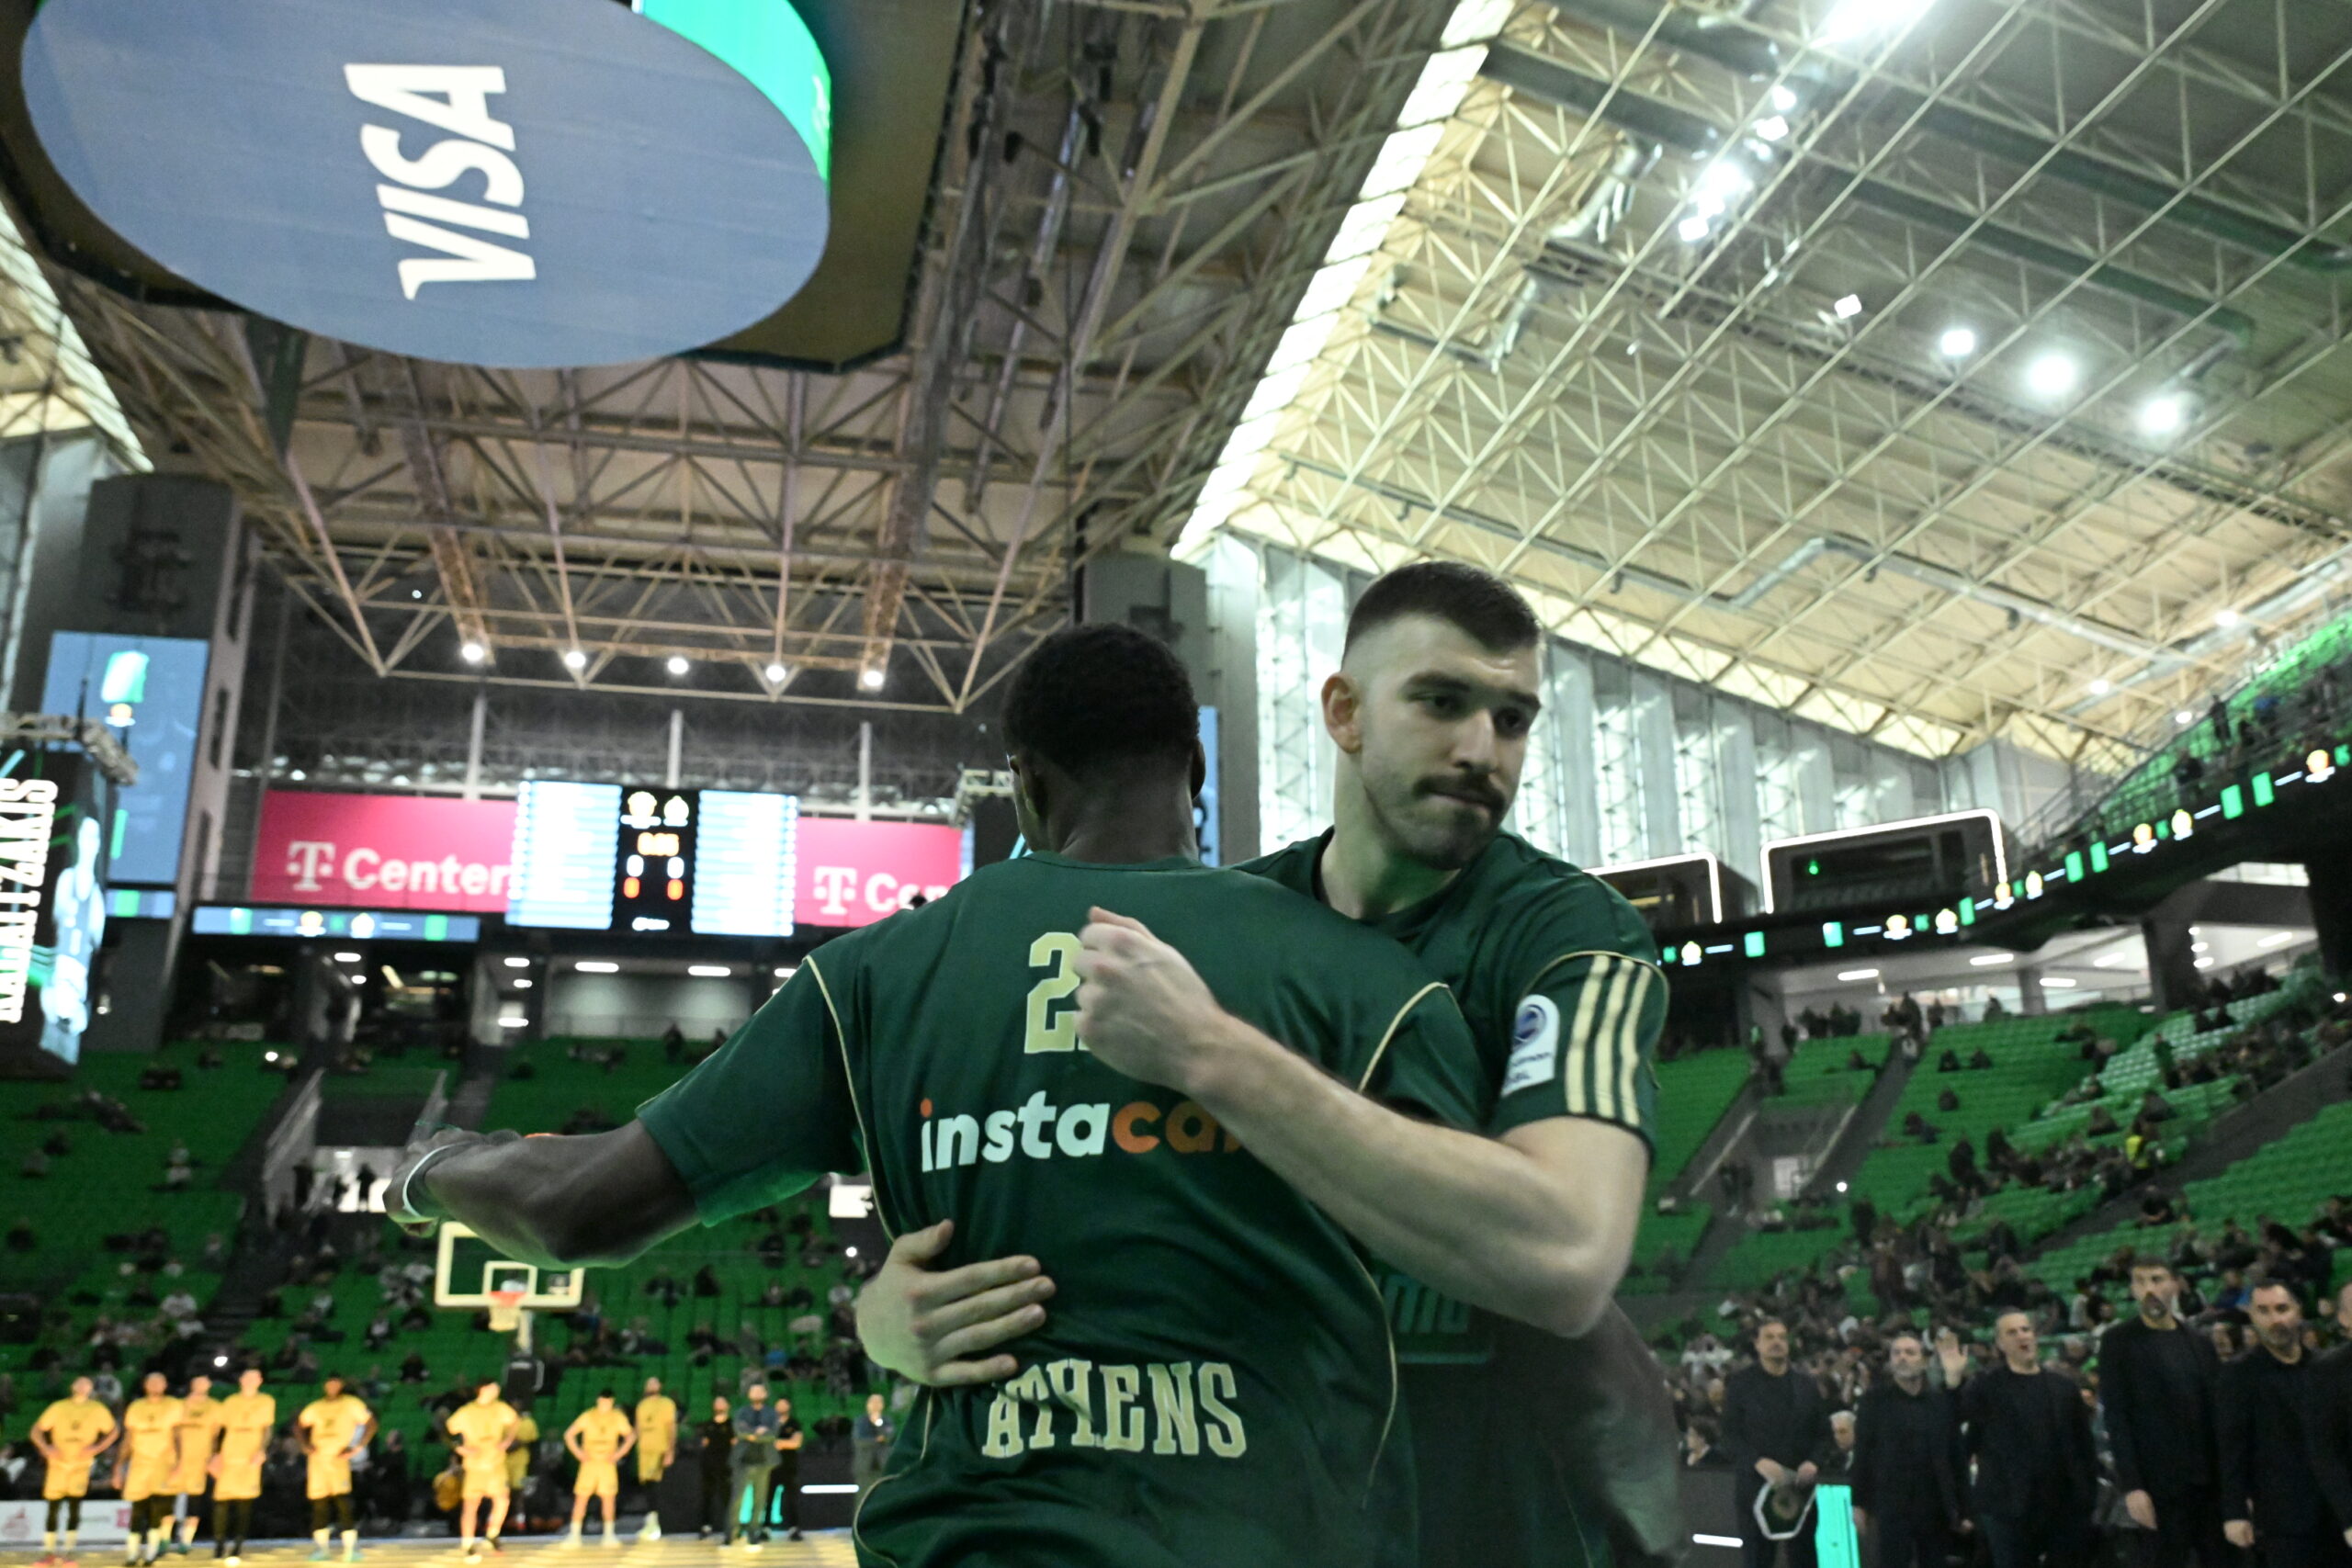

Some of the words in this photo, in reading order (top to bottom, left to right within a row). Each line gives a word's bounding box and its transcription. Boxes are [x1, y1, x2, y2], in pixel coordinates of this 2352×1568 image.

[343, 63, 537, 300] VISA
[343, 847, 512, 896] Center
[1023, 931, 1091, 1054] 2
[920, 1090, 1241, 1172] instaca
[981, 1358, 1247, 1459] ATHENS
